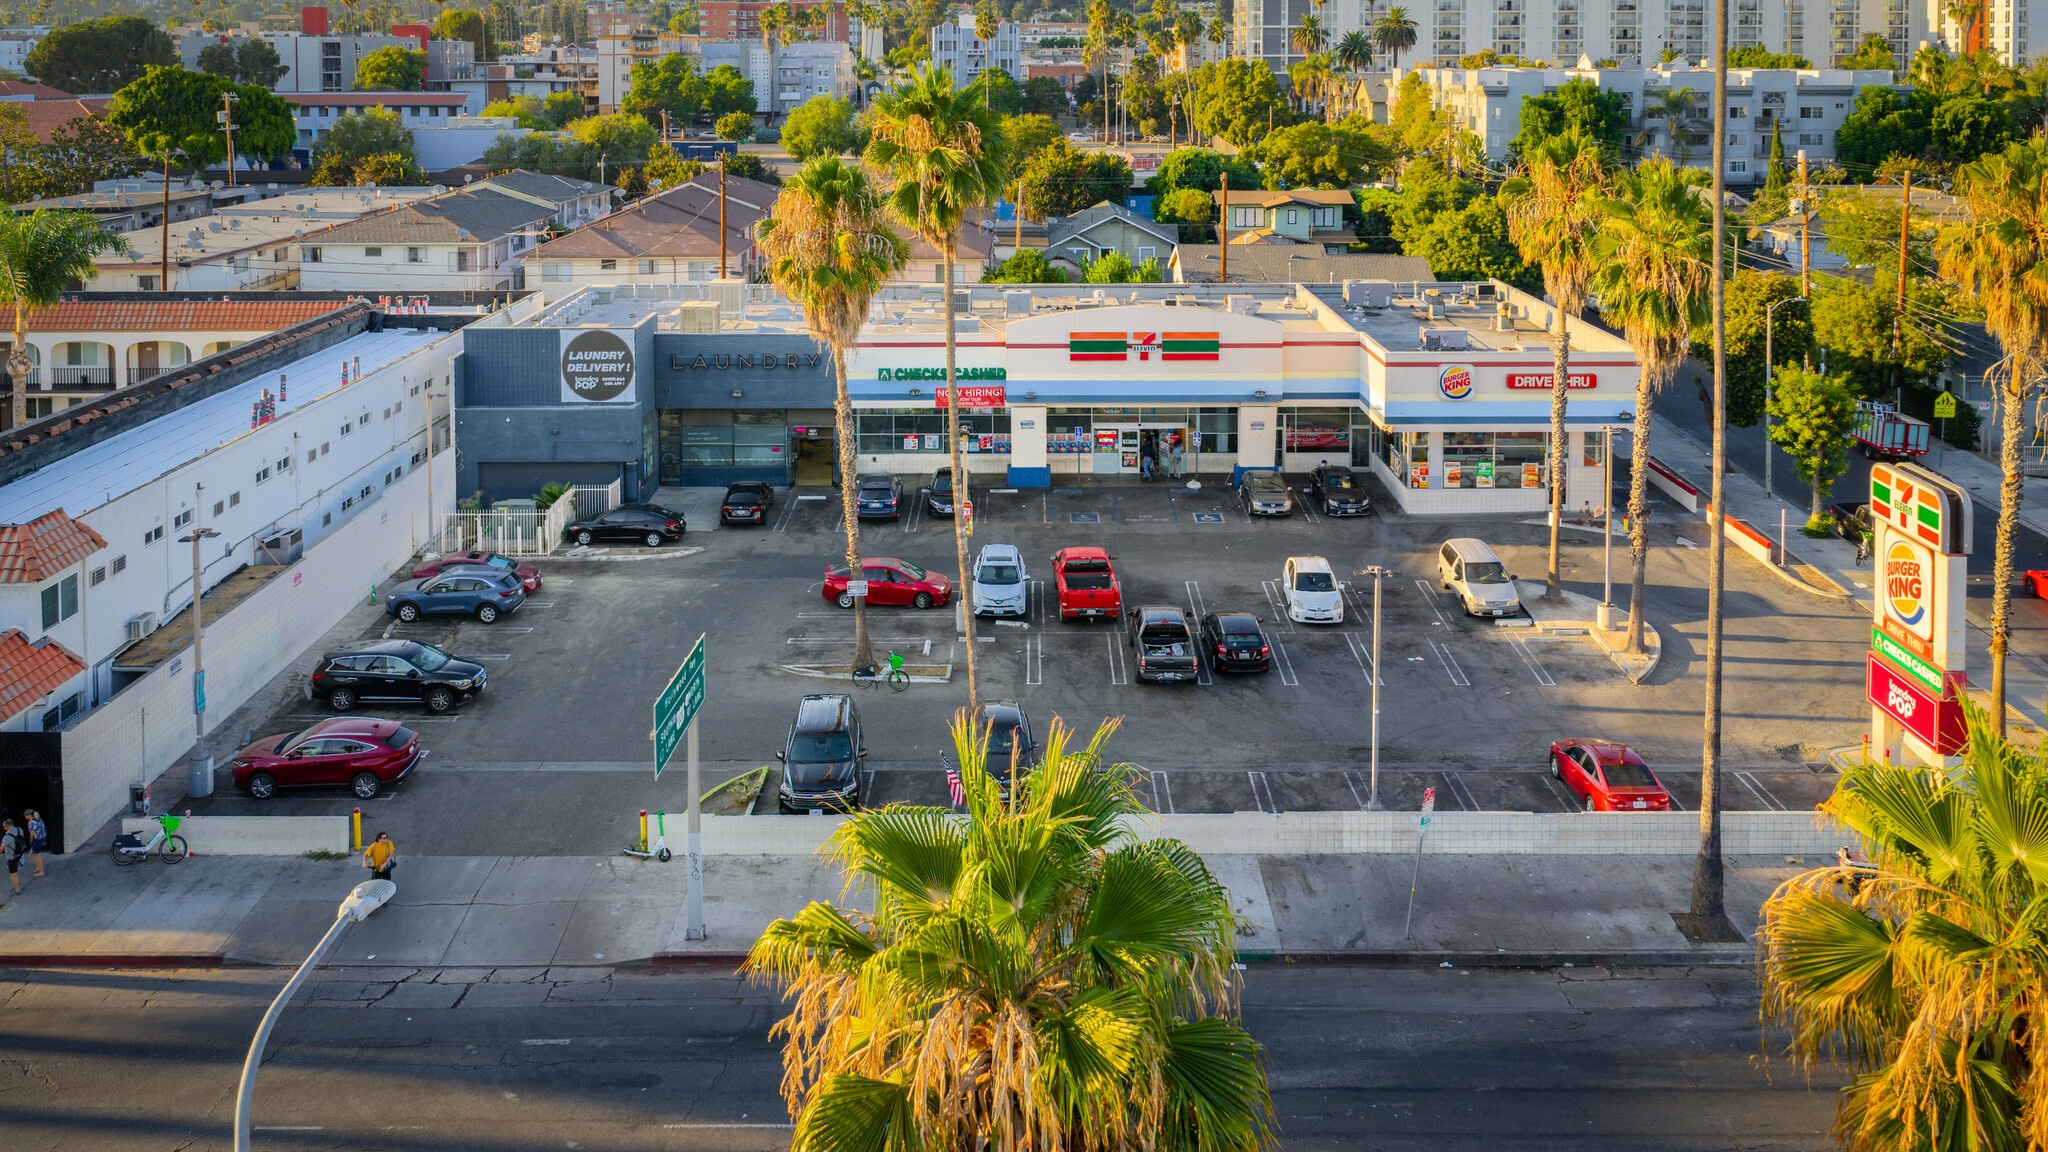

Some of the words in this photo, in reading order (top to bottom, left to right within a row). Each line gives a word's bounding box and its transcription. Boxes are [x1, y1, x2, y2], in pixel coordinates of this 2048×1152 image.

[568, 351, 625, 360] LAUNDRY
[672, 354, 821, 370] LAUNDRY
[895, 367, 947, 381] CHECKS
[956, 367, 1006, 381] CASHED
[1443, 370, 1470, 383] BURGER
[1515, 376, 1552, 387] DRIVE
[1566, 376, 1590, 387] HRU
[965, 388, 1003, 397] HIRING!
[1444, 377, 1471, 393] KING
[1887, 561, 1920, 578] BURGER
[1888, 577, 1921, 599] KING
[1886, 620, 1905, 641] DRIVE
[1906, 633, 1924, 654] THRU
[1883, 639, 1912, 668] CHECKS
[1911, 659, 1942, 689] CASHED
[1889, 678, 1916, 710] laundry
